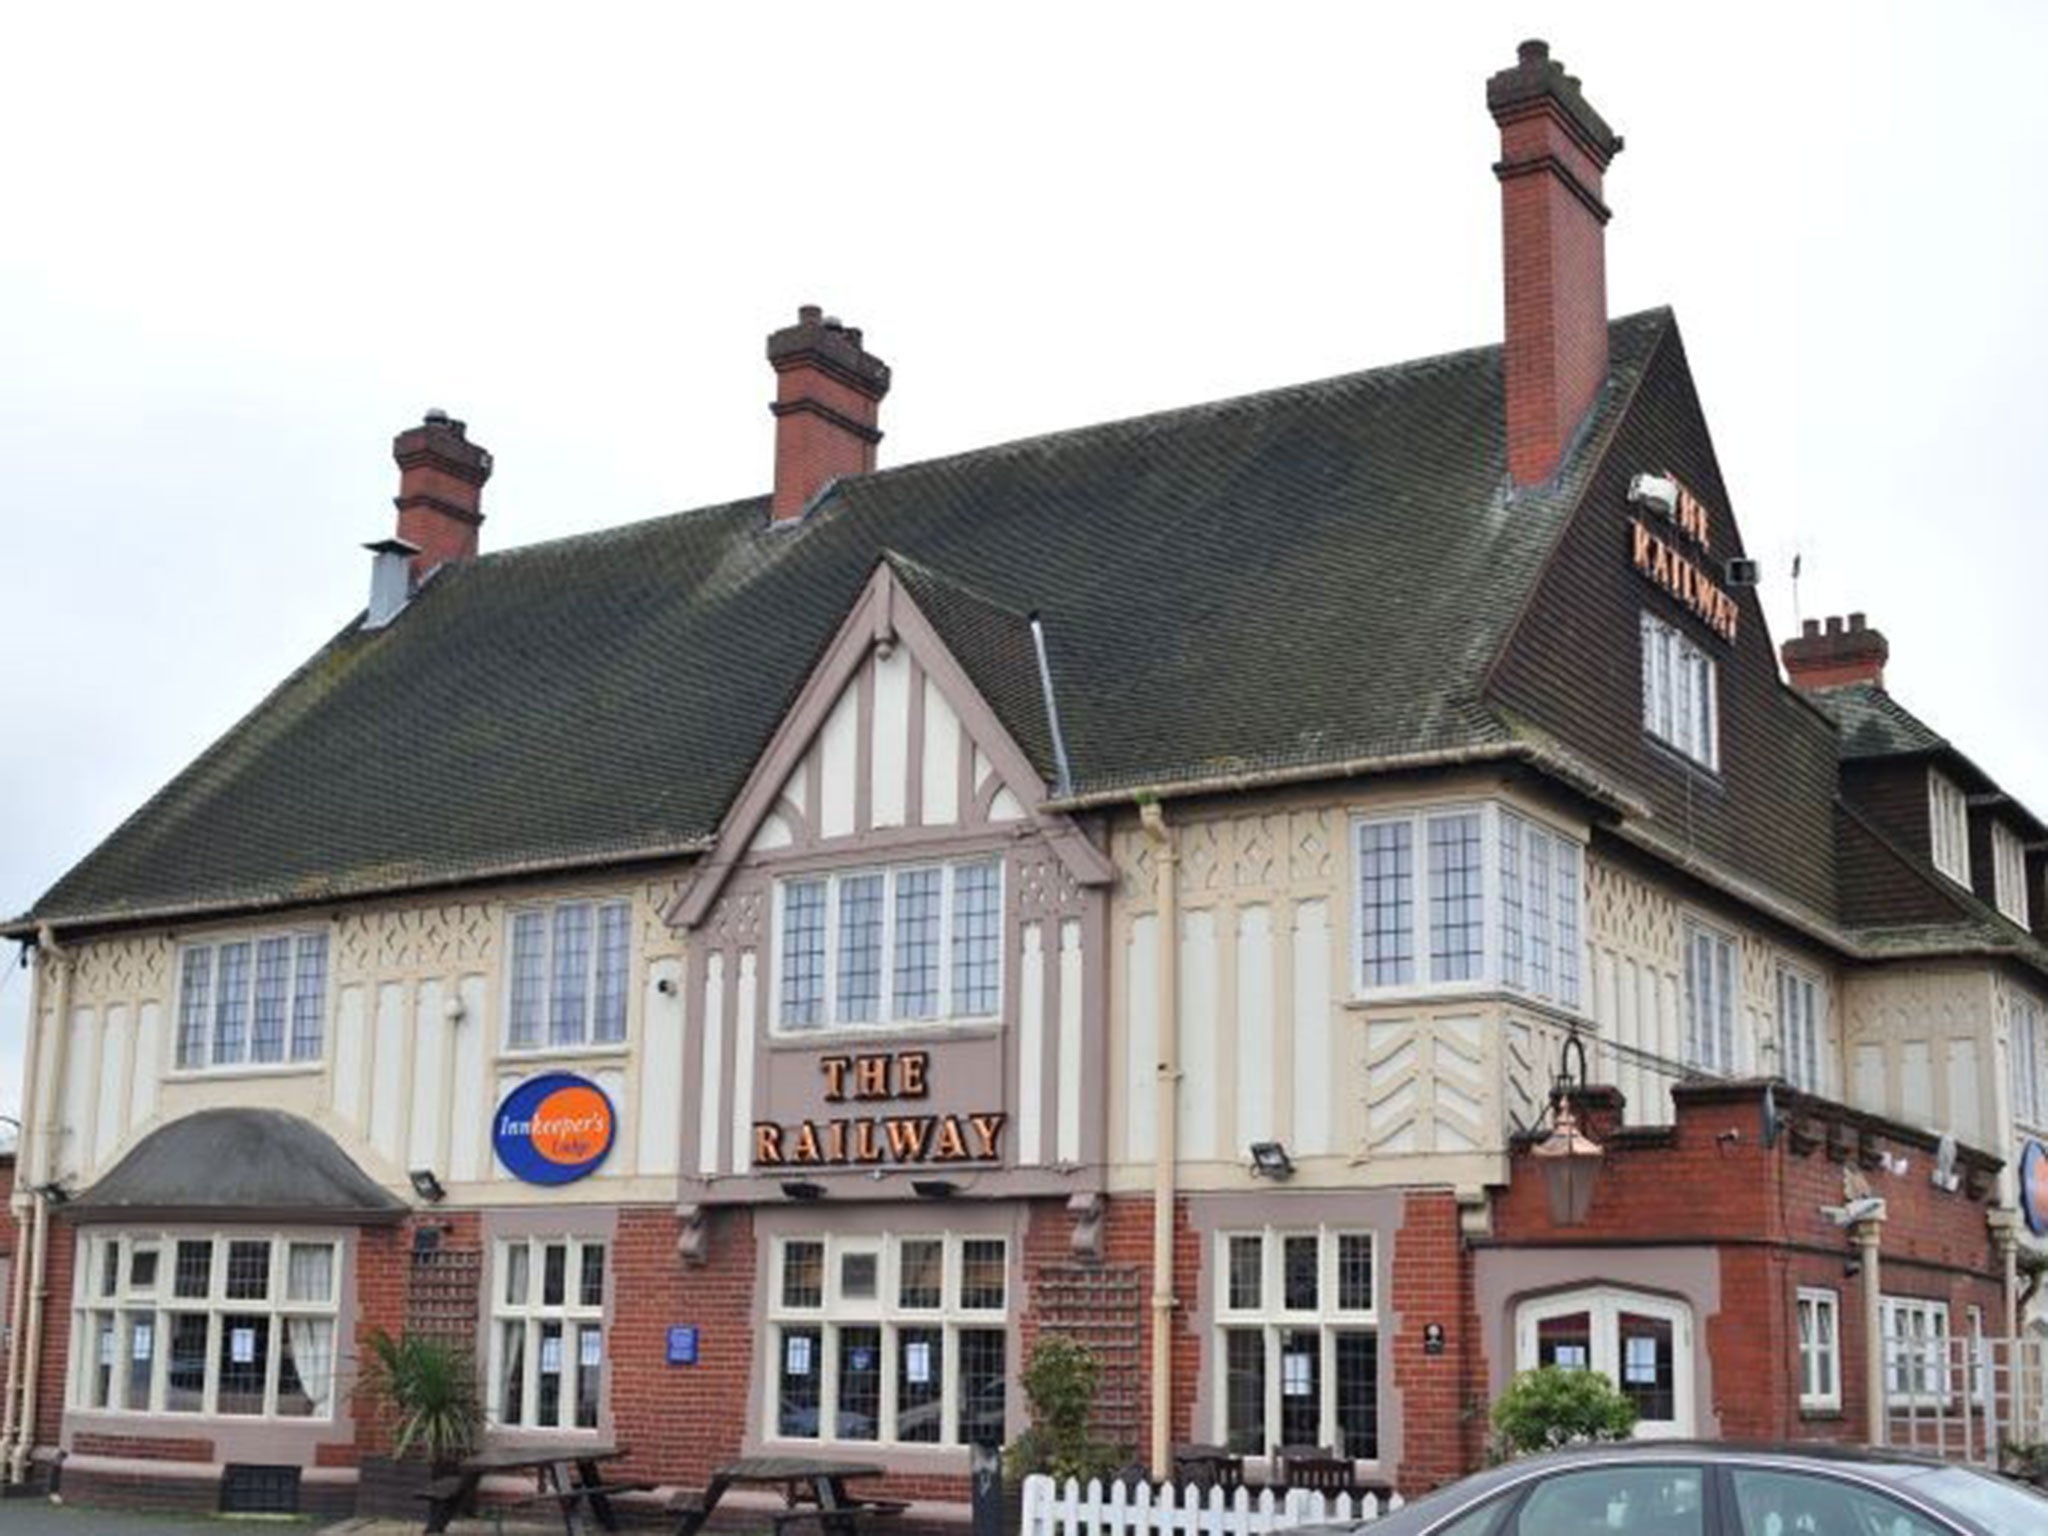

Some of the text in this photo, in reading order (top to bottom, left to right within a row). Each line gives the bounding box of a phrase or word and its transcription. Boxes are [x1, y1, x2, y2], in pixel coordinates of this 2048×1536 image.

[1664, 471, 1710, 553] HE
[1628, 516, 1739, 646] RAILWAY
[821, 1052, 928, 1103] THE
[500, 1112, 604, 1140] Innkeeper's
[753, 1112, 1007, 1166] RAILWAY
